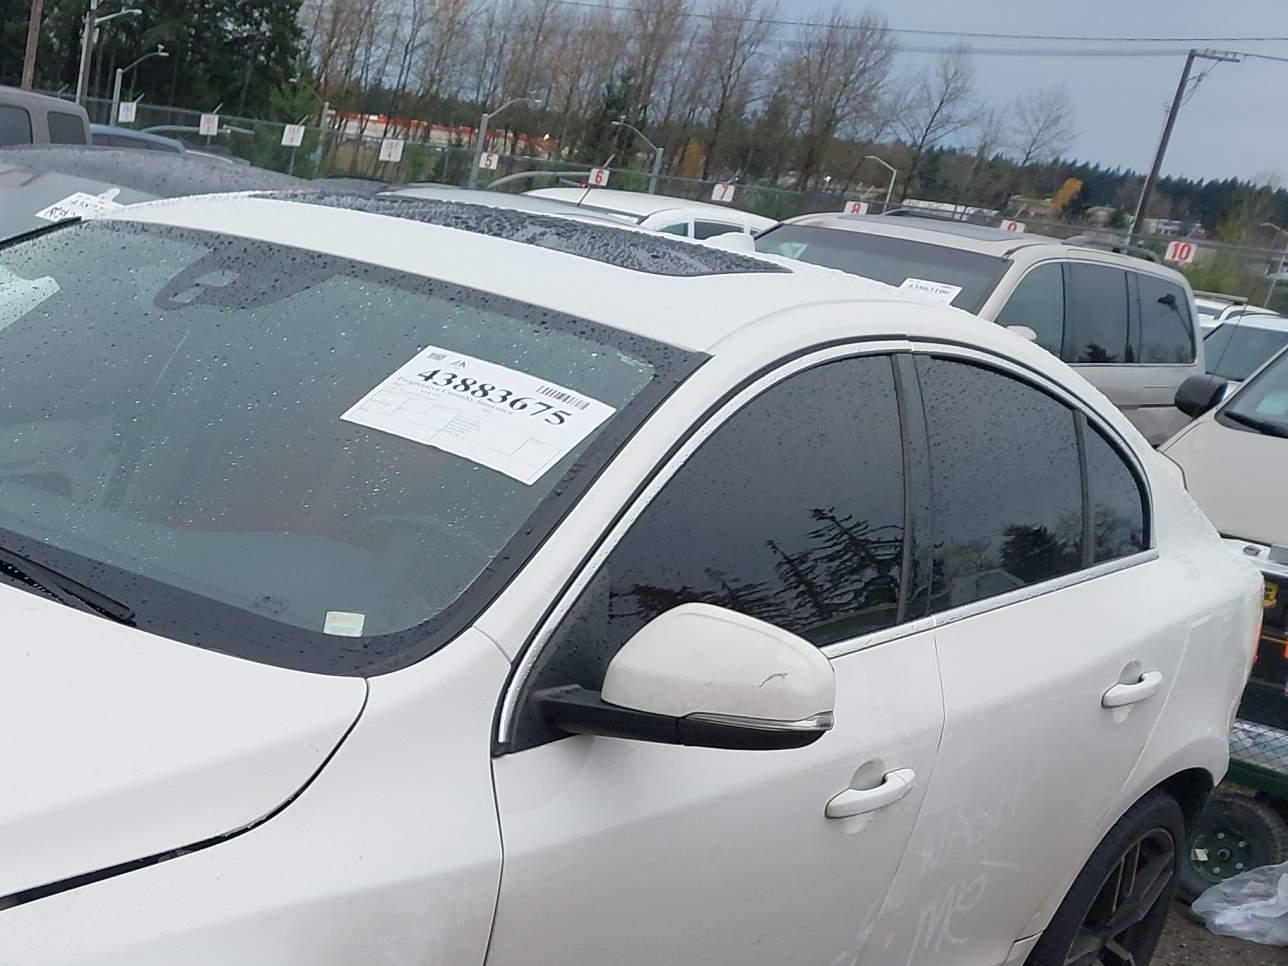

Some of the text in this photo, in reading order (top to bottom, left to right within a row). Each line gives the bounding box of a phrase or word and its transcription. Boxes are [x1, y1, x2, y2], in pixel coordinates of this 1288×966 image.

[484, 154, 493, 168] 5
[594, 170, 604, 184] 6
[719, 185, 729, 200] 7
[1172, 242, 1192, 260] 10
[416, 368, 573, 426] 43883675
